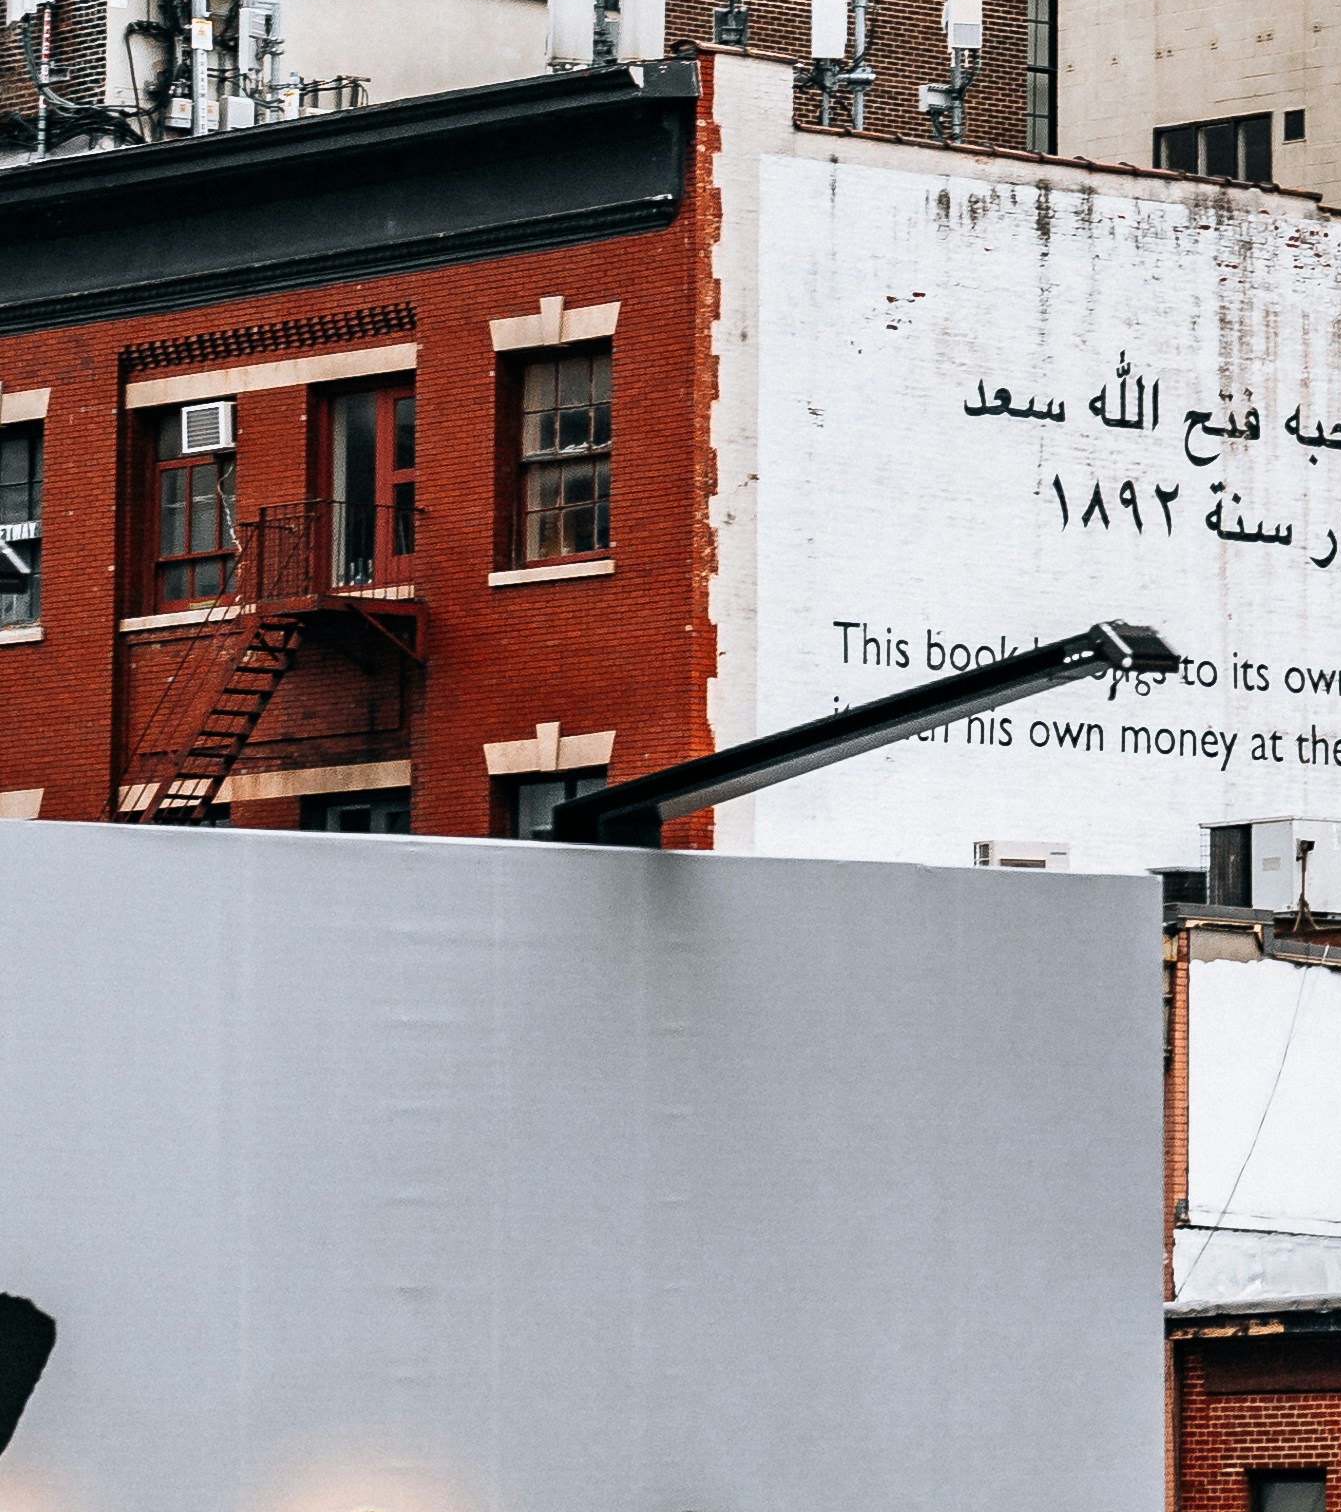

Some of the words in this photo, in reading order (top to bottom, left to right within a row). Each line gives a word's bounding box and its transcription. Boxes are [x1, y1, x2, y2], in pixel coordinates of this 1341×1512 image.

[963, 378, 1066, 423] سعد
[1183, 388, 1261, 467] فتح
[1205, 481, 1293, 546] سنة
[832, 620, 910, 669] This
[1183, 656, 1218, 688] to
[1232, 651, 1270, 692] its
[967, 707, 1014, 748] his
[1028, 719, 1104, 752] own
[1120, 722, 1238, 772] money
[1250, 729, 1284, 763] at
